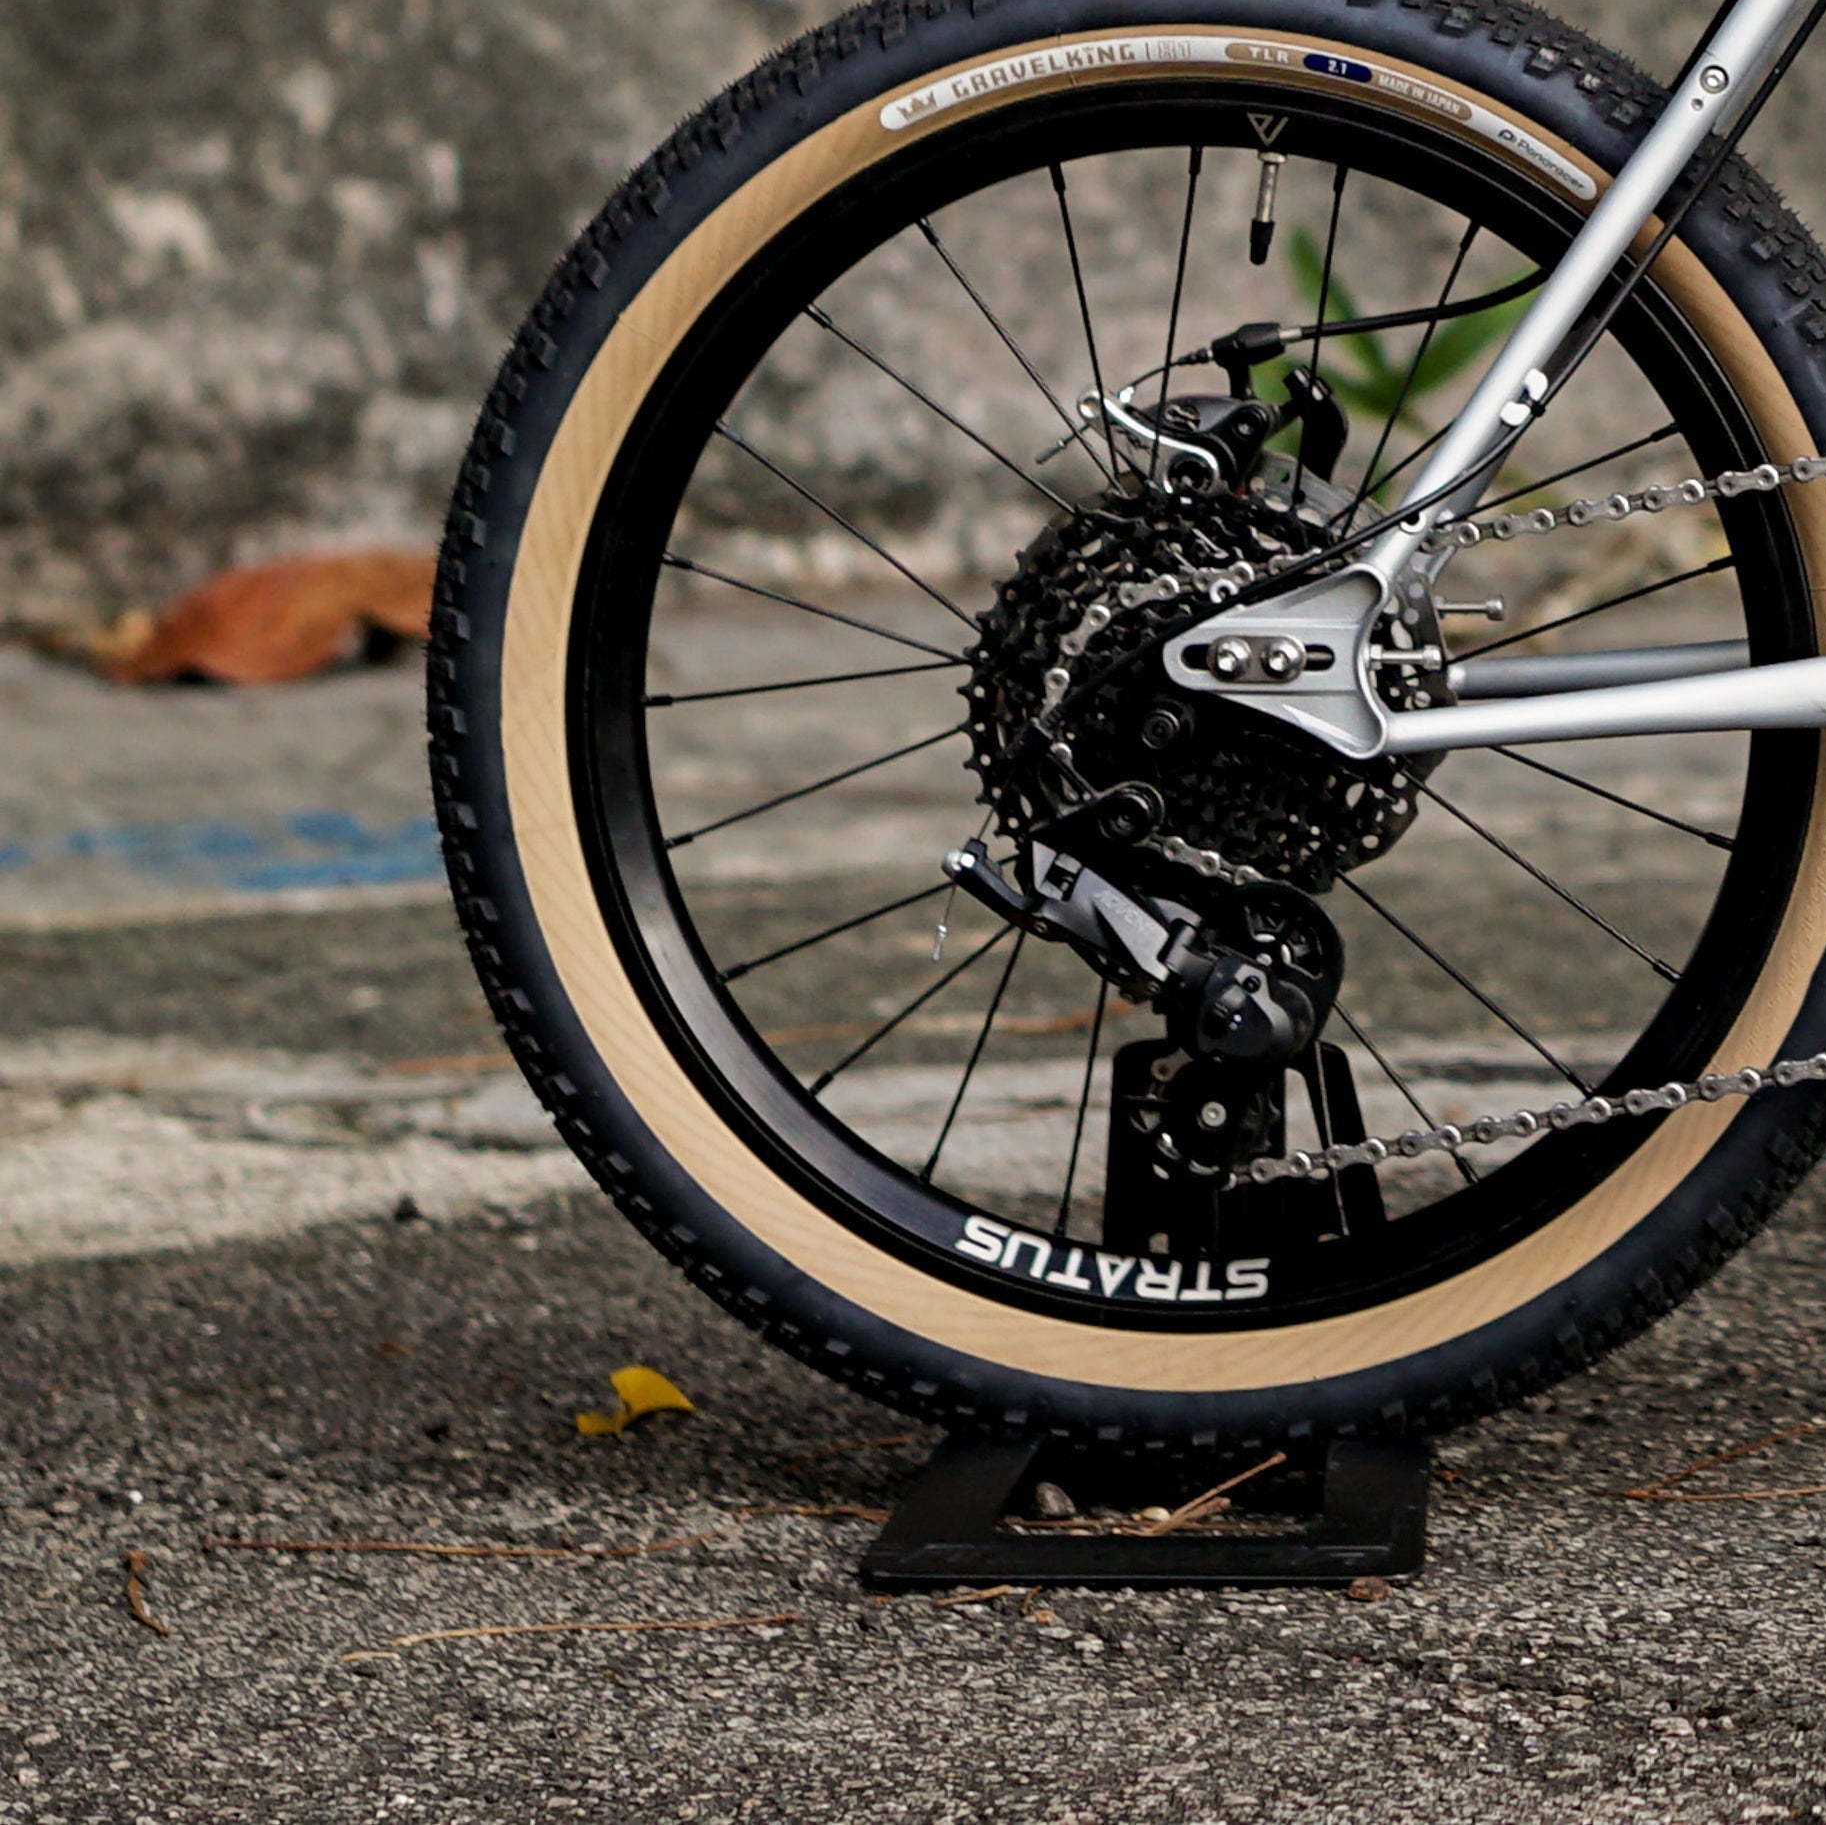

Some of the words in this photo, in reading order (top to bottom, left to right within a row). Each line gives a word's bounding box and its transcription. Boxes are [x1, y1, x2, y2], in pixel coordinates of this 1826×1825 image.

[1248, 46, 1289, 63] TLR
[1327, 60, 1347, 75] 2.1
[1378, 75, 1409, 95] MADE
[1411, 85, 1426, 101] IN
[1426, 91, 1461, 115] JAPAN
[1517, 138, 1585, 190] Panaracer
[954, 1214, 1271, 1301] STRATUS
